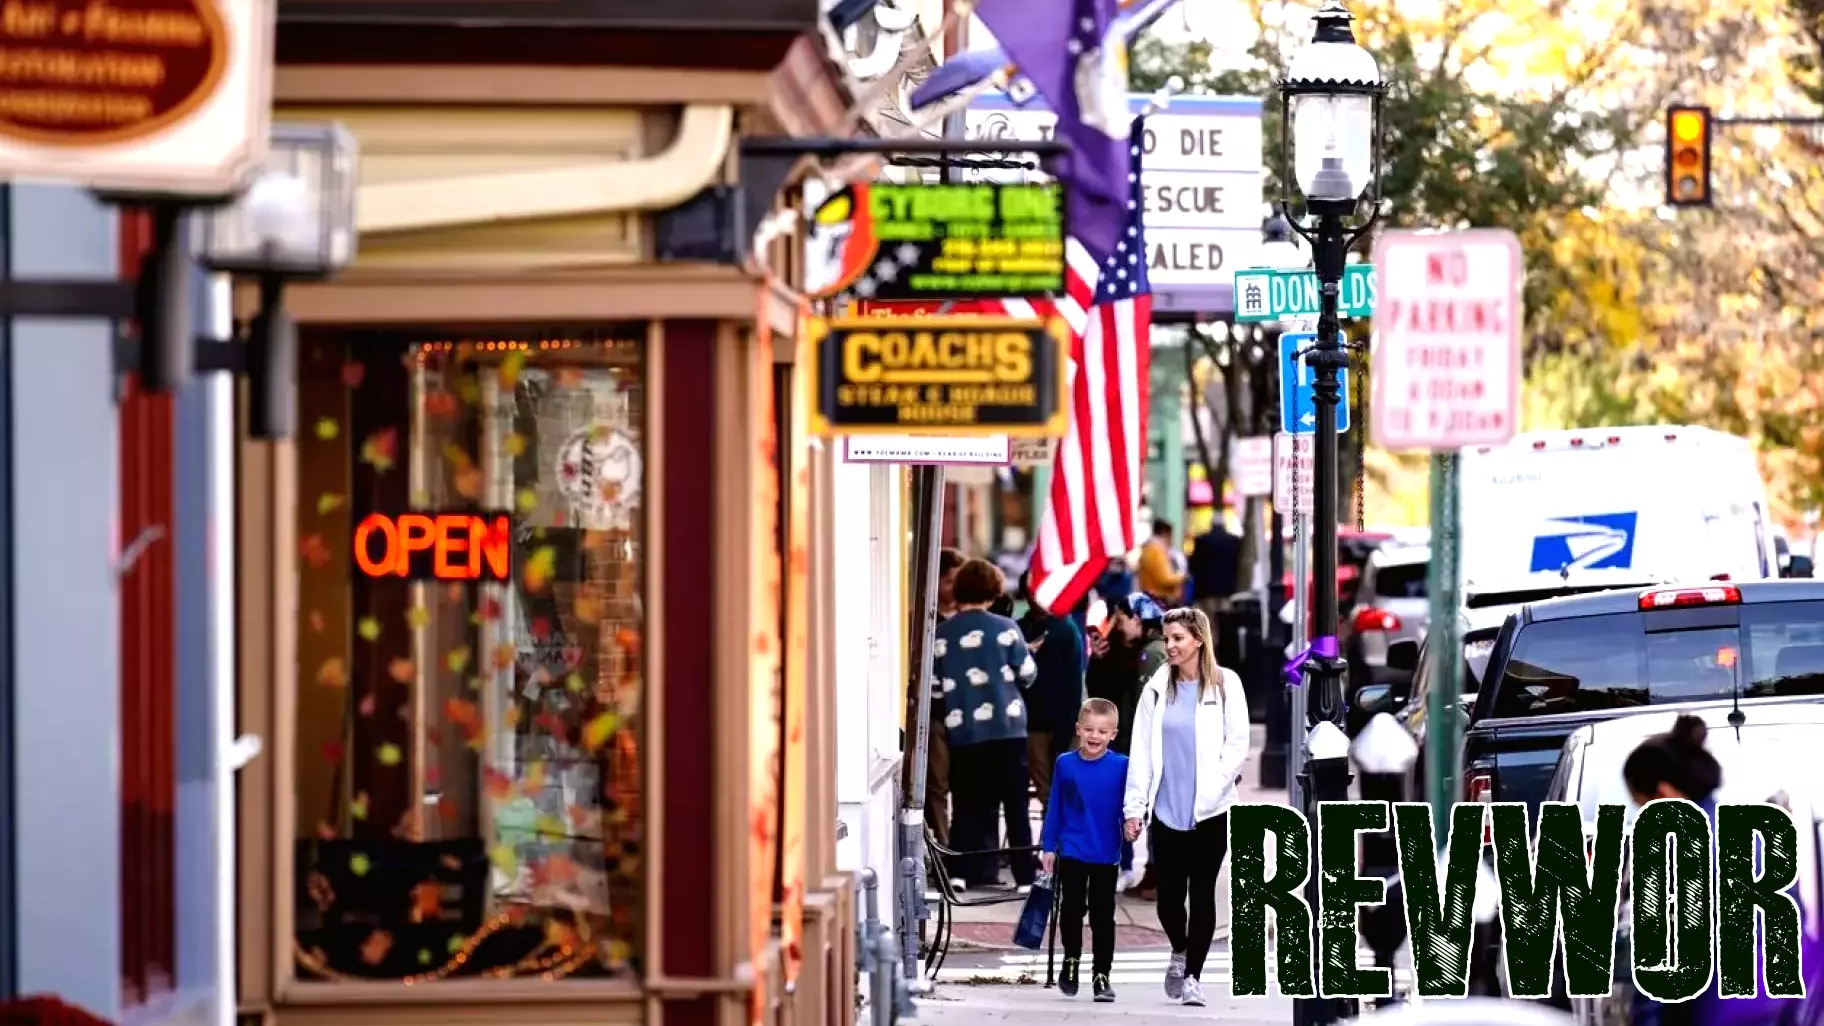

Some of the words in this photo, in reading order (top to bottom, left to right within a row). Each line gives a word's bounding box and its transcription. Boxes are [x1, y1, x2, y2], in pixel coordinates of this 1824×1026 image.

[1142, 128, 1157, 156] O
[1180, 129, 1224, 156] DIE
[1142, 186, 1224, 213] ESCUE
[1144, 243, 1224, 271] ALED
[1426, 252, 1469, 287] NO
[1271, 271, 1378, 313] DONLDS
[1386, 299, 1506, 333] PARKING
[844, 332, 1032, 384] COACHS
[354, 512, 510, 579] OPEN
